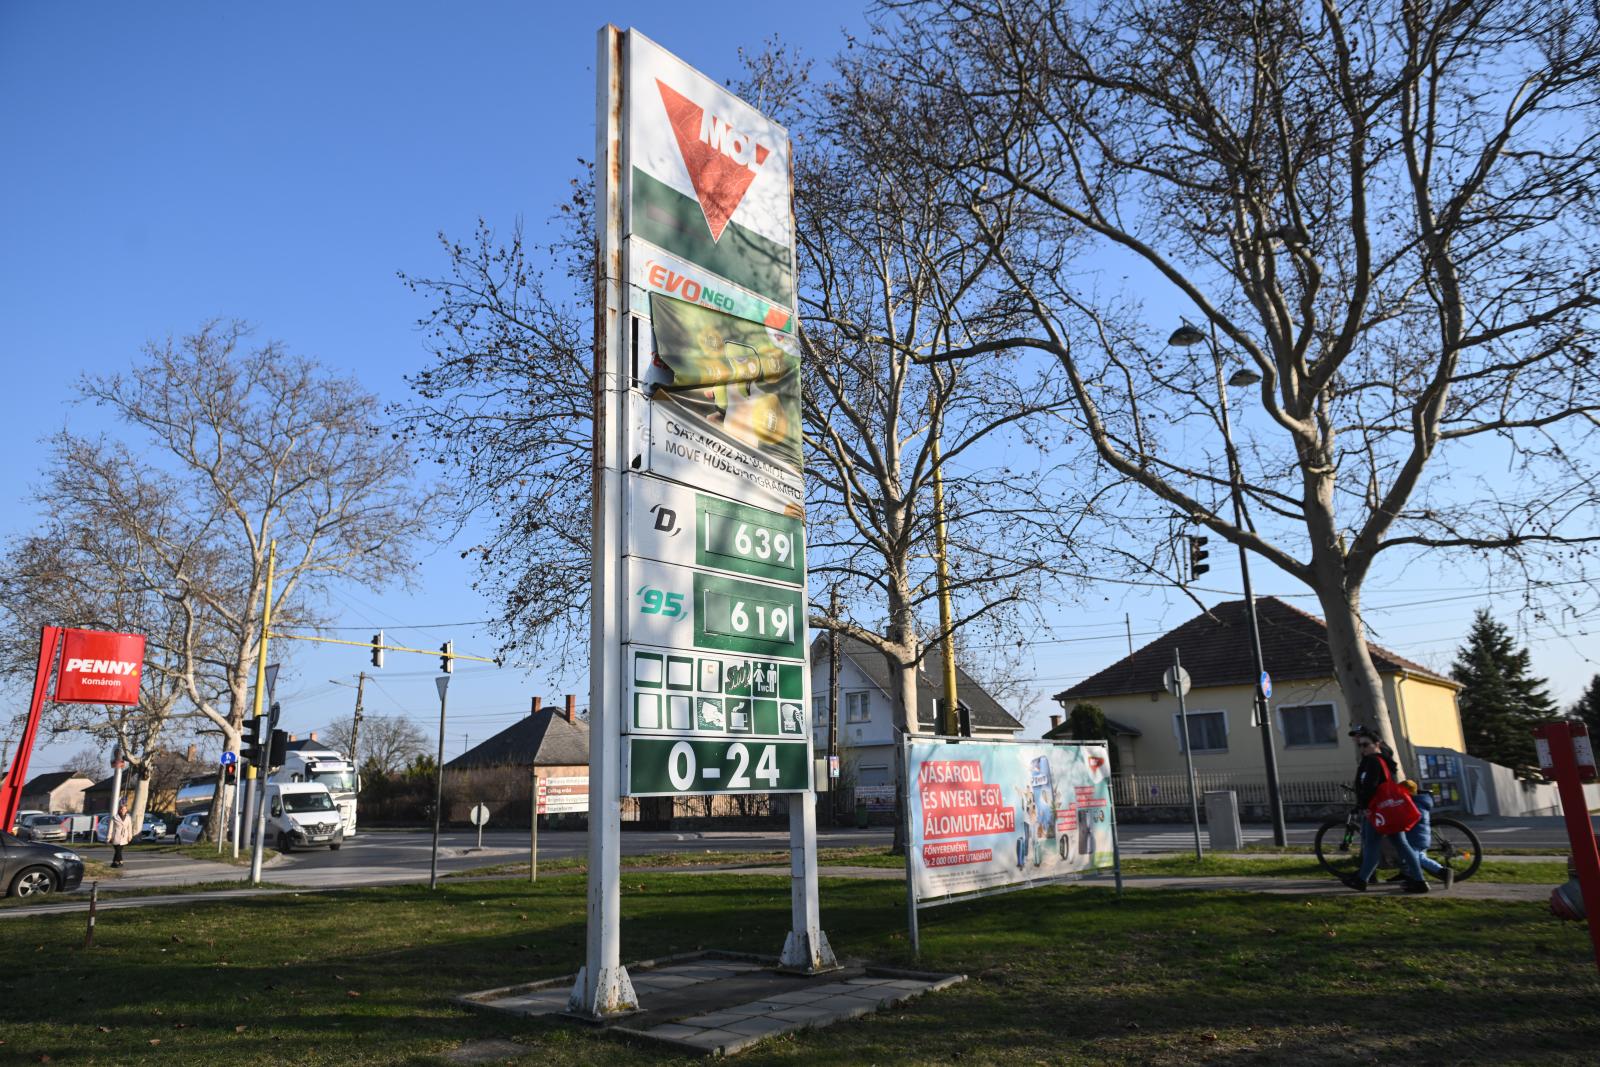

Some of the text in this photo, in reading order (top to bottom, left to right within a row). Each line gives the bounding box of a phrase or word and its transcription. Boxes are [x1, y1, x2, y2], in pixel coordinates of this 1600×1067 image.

[700, 106, 771, 173] MOL
[702, 286, 735, 311] NEO
[665, 439, 701, 463] MOVE
[735, 524, 790, 563] 639
[731, 601, 788, 637] 619
[81, 677, 122, 687] Komárom
[760, 684, 770, 693] WC
[919, 761, 982, 784] VÁSÁROLJ
[922, 787, 1000, 809] ÉS NYERJ EGY
[924, 807, 1015, 836] ÁLOMUTAZÁST!
